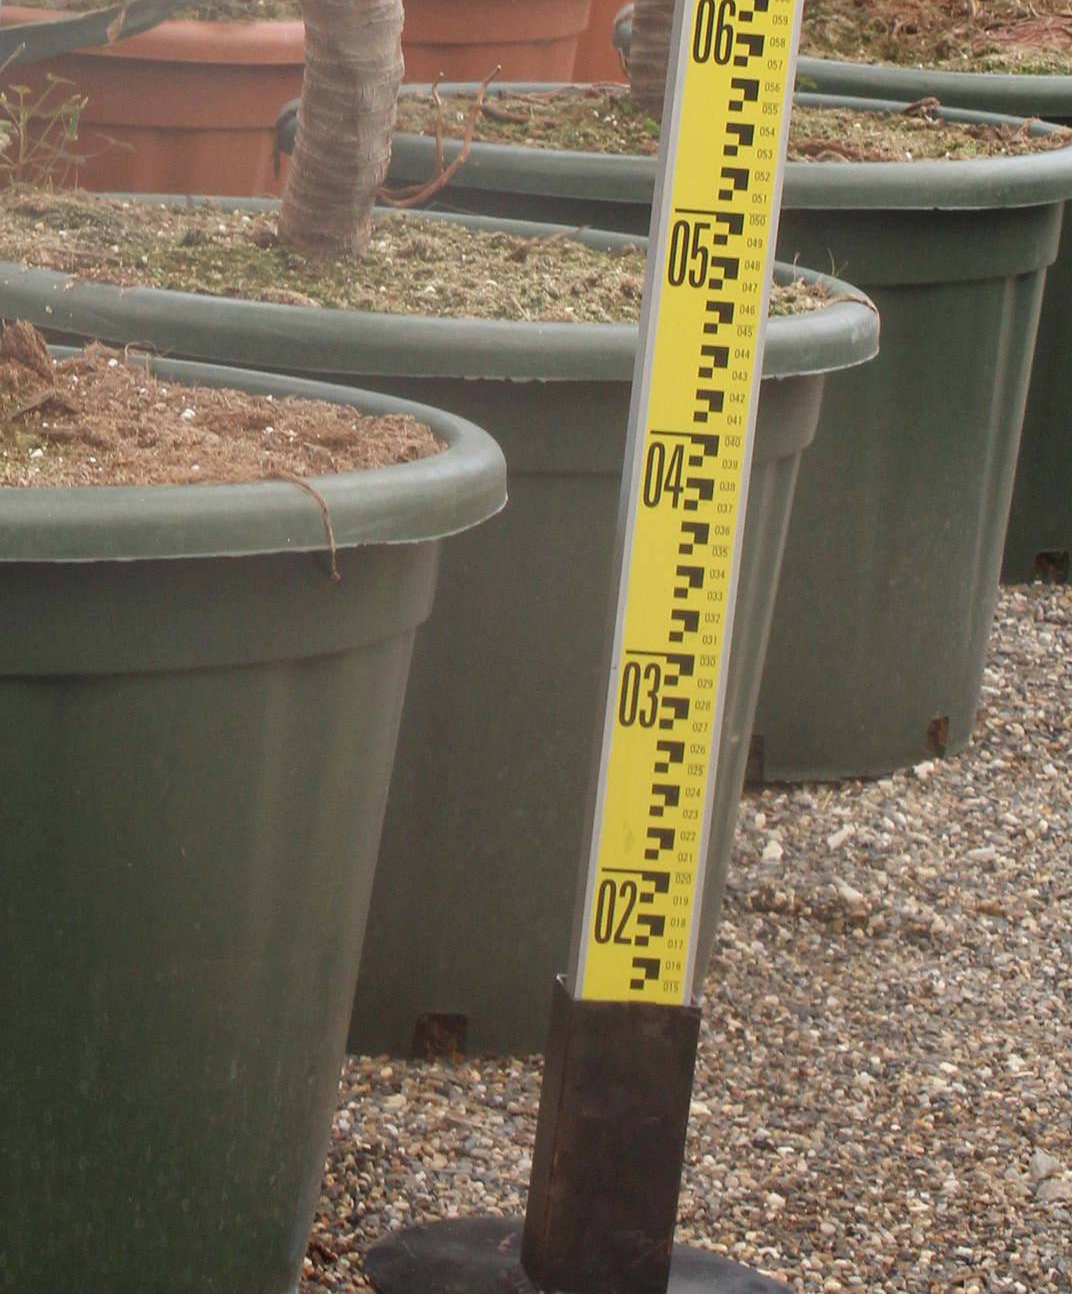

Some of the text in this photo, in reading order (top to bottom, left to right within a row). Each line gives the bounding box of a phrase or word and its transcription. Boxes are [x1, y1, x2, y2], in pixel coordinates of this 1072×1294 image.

[771, 13, 789, 26] 059
[769, 36, 787, 48] 058
[767, 58, 784, 70] 057
[763, 81, 781, 92] 056
[759, 125, 776, 138] 054
[756, 147, 774, 160] 053
[753, 169, 771, 182] 052
[751, 193, 768, 204] 051
[746, 237, 764, 248] 049
[668, 220, 710, 288] 05
[743, 259, 761, 271] 048
[741, 281, 759, 293] 047
[739, 303, 756, 315] 046
[733, 348, 751, 360] 044
[731, 370, 749, 382] 043
[729, 393, 746, 404] 042
[726, 414, 743, 426] 041
[721, 458, 739, 470] 039
[643, 441, 684, 509] 04
[716, 503, 733, 514] 037
[714, 524, 731, 536] 036
[709, 569, 725, 579] 034
[706, 590, 724, 602] 033
[704, 611, 721, 624] 032
[701, 633, 718, 646] 031
[619, 661, 661, 728] 03
[594, 879, 638, 945] 02
